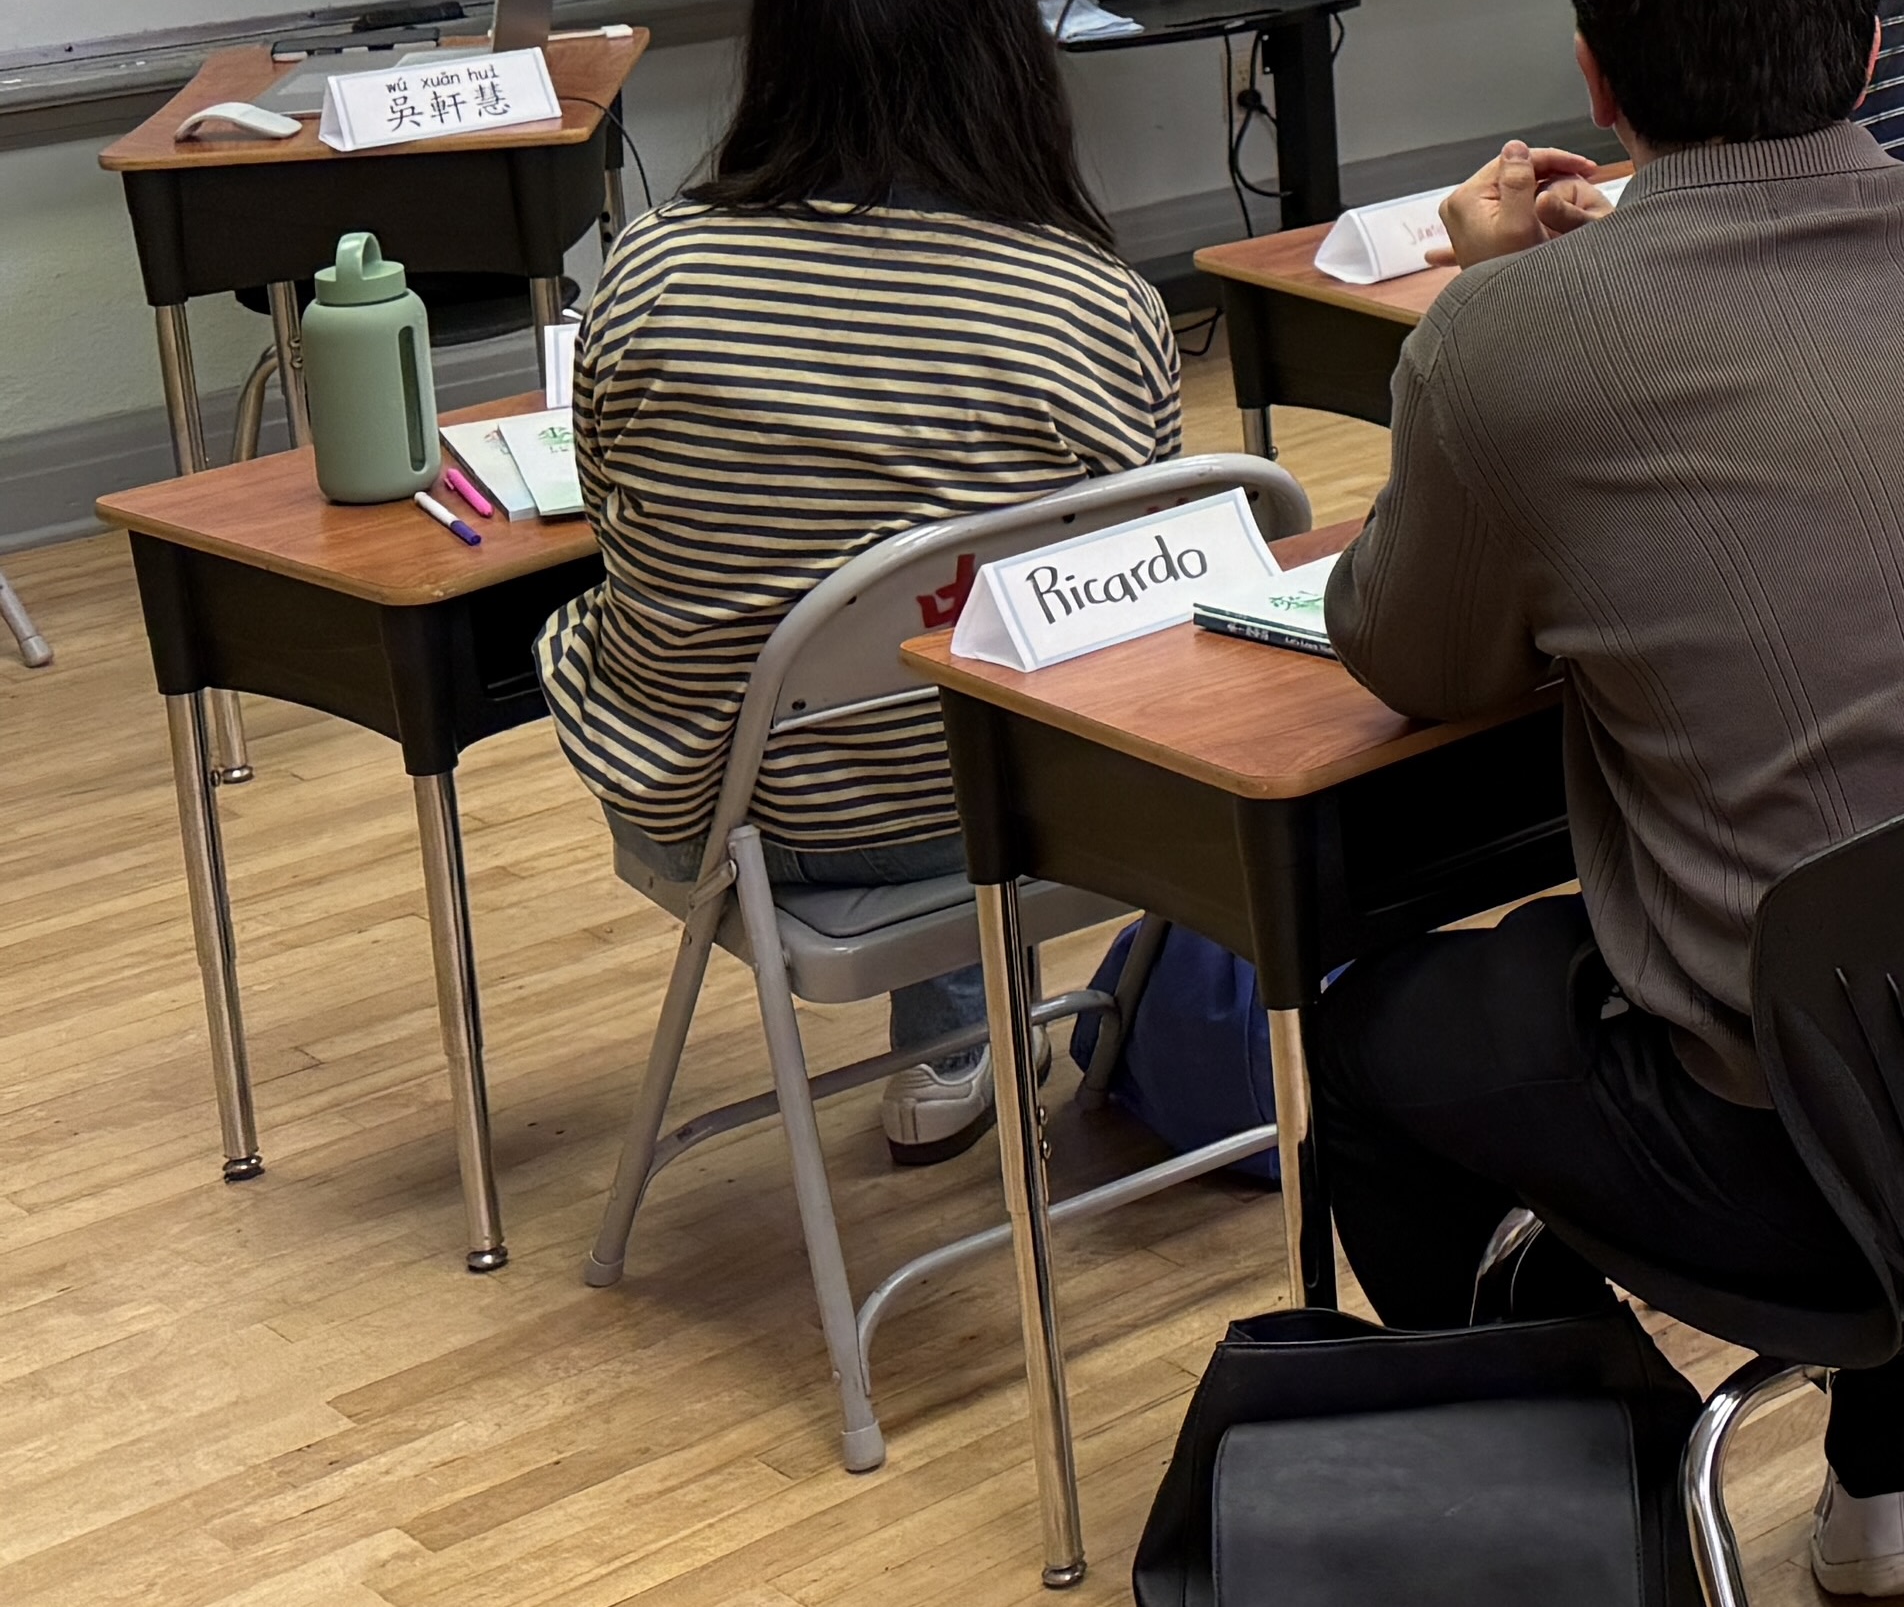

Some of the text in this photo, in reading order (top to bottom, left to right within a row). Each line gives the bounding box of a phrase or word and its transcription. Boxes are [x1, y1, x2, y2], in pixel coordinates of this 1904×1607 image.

[386, 80, 512, 132] 吳軒慧
[1025, 534, 1208, 625] Ricardo
